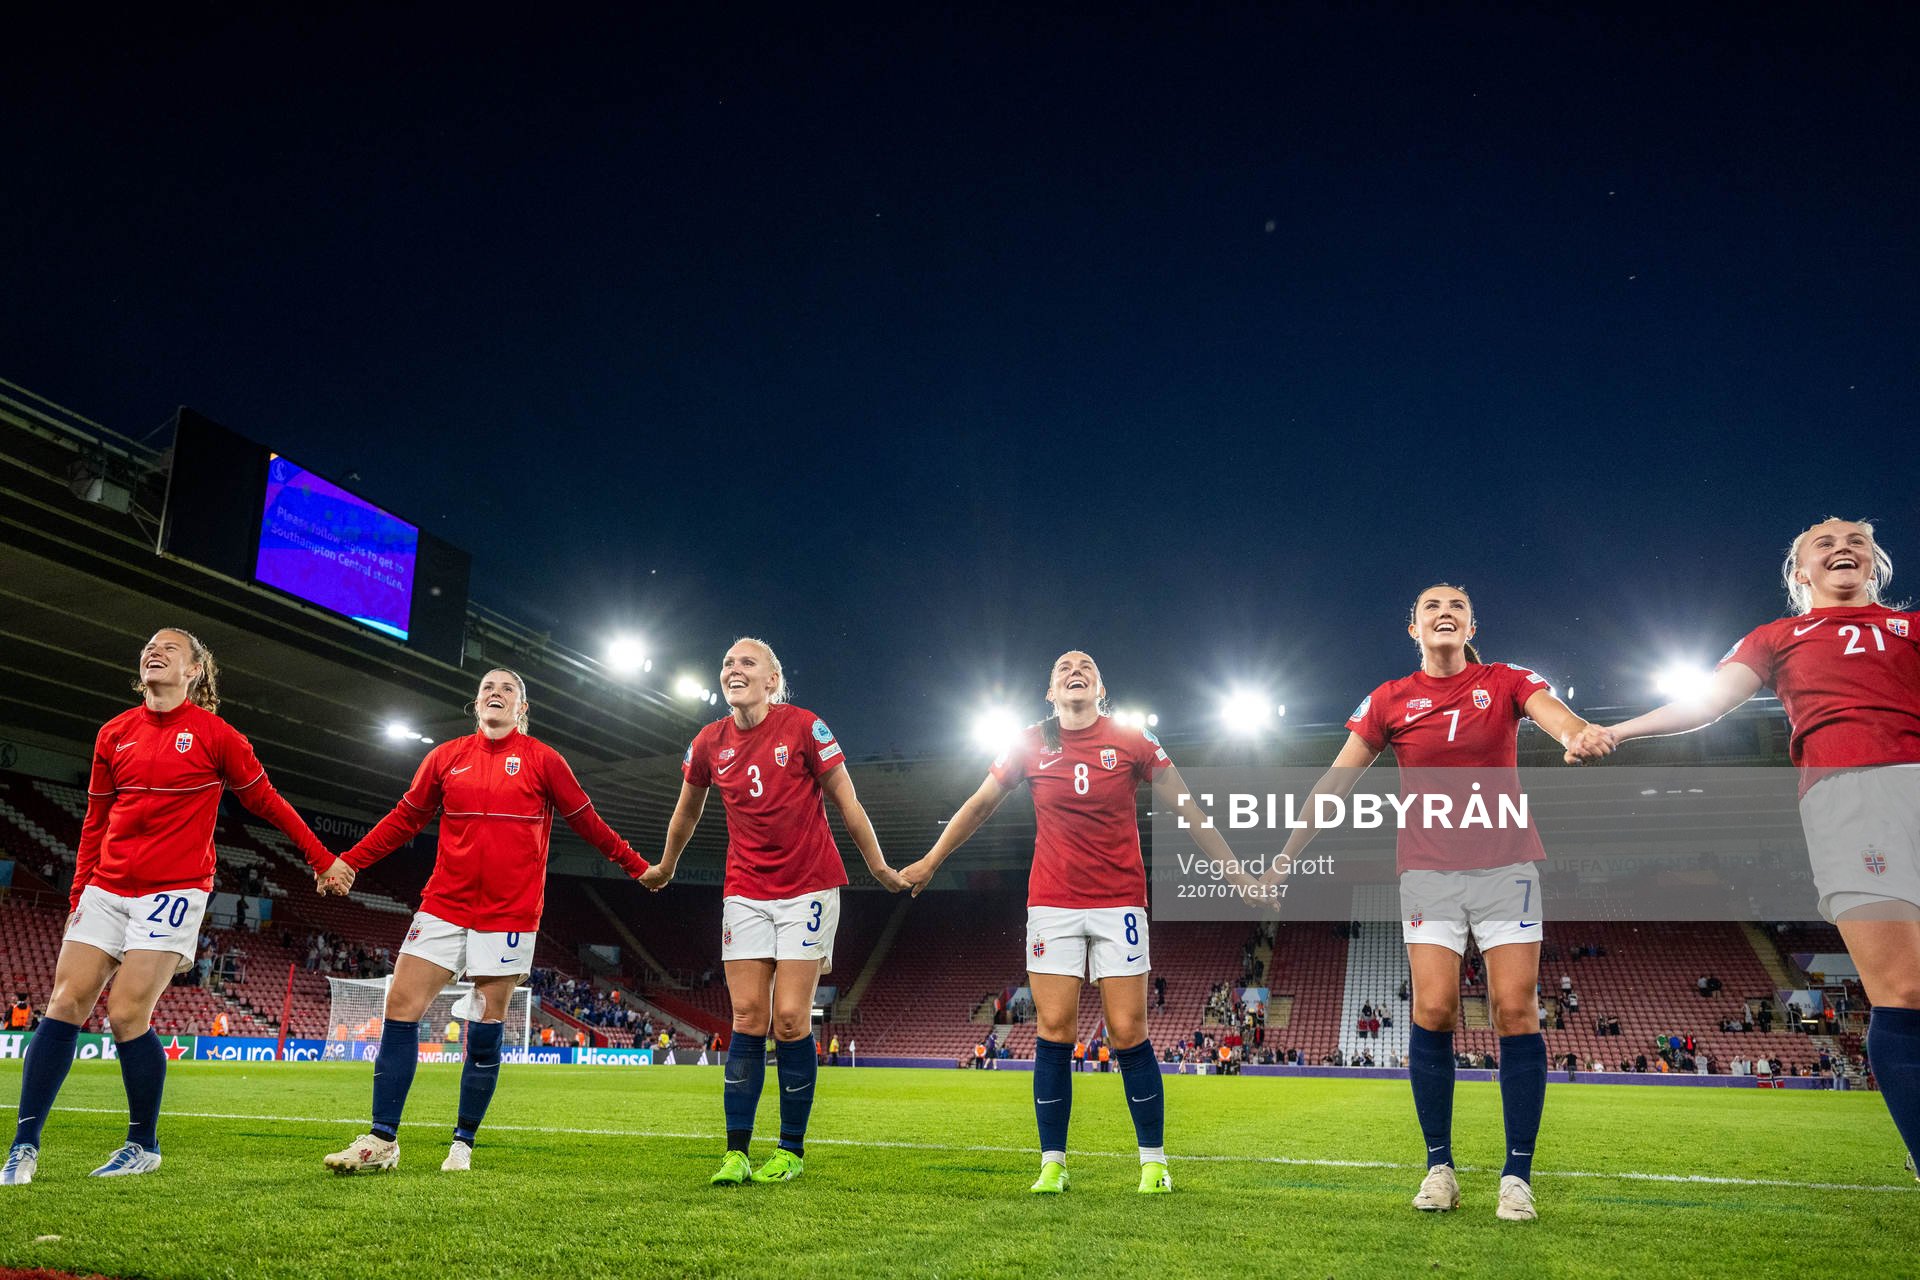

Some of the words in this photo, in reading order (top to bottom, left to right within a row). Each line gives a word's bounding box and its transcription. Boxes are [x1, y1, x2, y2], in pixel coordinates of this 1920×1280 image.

[271, 523, 336, 561] Southampton
[338, 552, 372, 577] Central
[277, 506, 308, 529] Please
[311, 523, 341, 545] follow
[378, 555, 394, 572] get
[1838, 623, 1886, 655] 21
[1443, 709, 1460, 741] 7
[747, 765, 763, 797] 3
[1074, 763, 1089, 795] 8
[147, 893, 189, 928] 20
[1515, 879, 1532, 913] 7
[807, 901, 822, 932] 3
[1124, 912, 1138, 945] 8
[577, 1047, 650, 1065] Hisense
